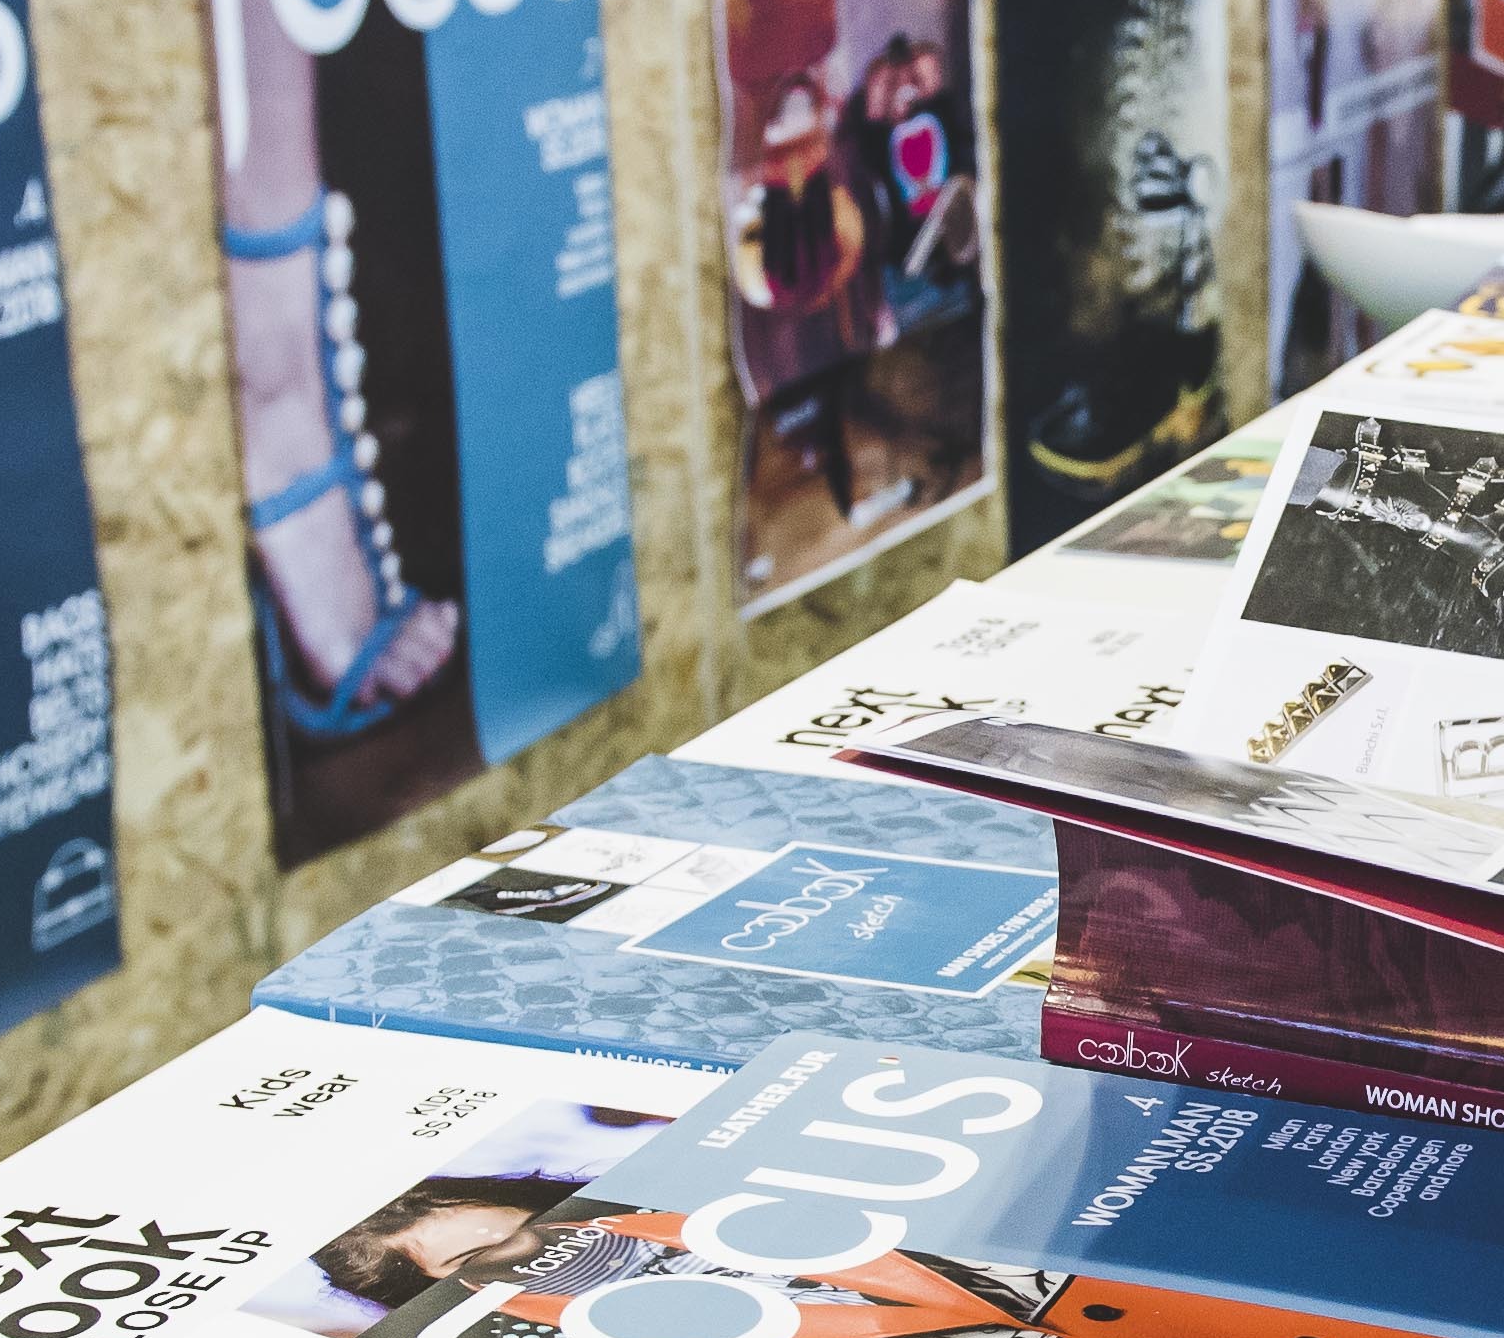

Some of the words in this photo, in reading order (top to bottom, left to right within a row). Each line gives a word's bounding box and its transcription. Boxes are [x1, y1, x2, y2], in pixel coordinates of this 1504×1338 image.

[778, 684, 916, 749] next
[846, 894, 904, 941] sketch
[218, 1066, 312, 1111] Kids
[272, 1073, 360, 1119] wear
[405, 1086, 466, 1116] KIDS
[411, 1120, 453, 1139] SS
[442, 1090, 498, 1120] 2018
[697, 1049, 838, 1150] LEATHER.FUR
[1205, 1066, 1282, 1096] sketch
[1365, 1084, 1458, 1121] WOMAN
[1174, 1108, 1260, 1174] SS.2018
[1261, 1118, 1307, 1151] Milan
[1291, 1121, 1335, 1152] Paris
[1307, 1126, 1363, 1171] London
[1327, 1156, 1361, 1187] New
[1354, 1130, 1391, 1163] york
[1071, 1101, 1223, 1227] WOMAN.MAN
[1350, 1134, 1418, 1198] Barcelona
[1367, 1138, 1447, 1219] Copenhagen
[1418, 1174, 1451, 1202] and
[1439, 1142, 1475, 1180] more
[220, 1229, 275, 1265] UP
[512, 1216, 623, 1277] fashion
